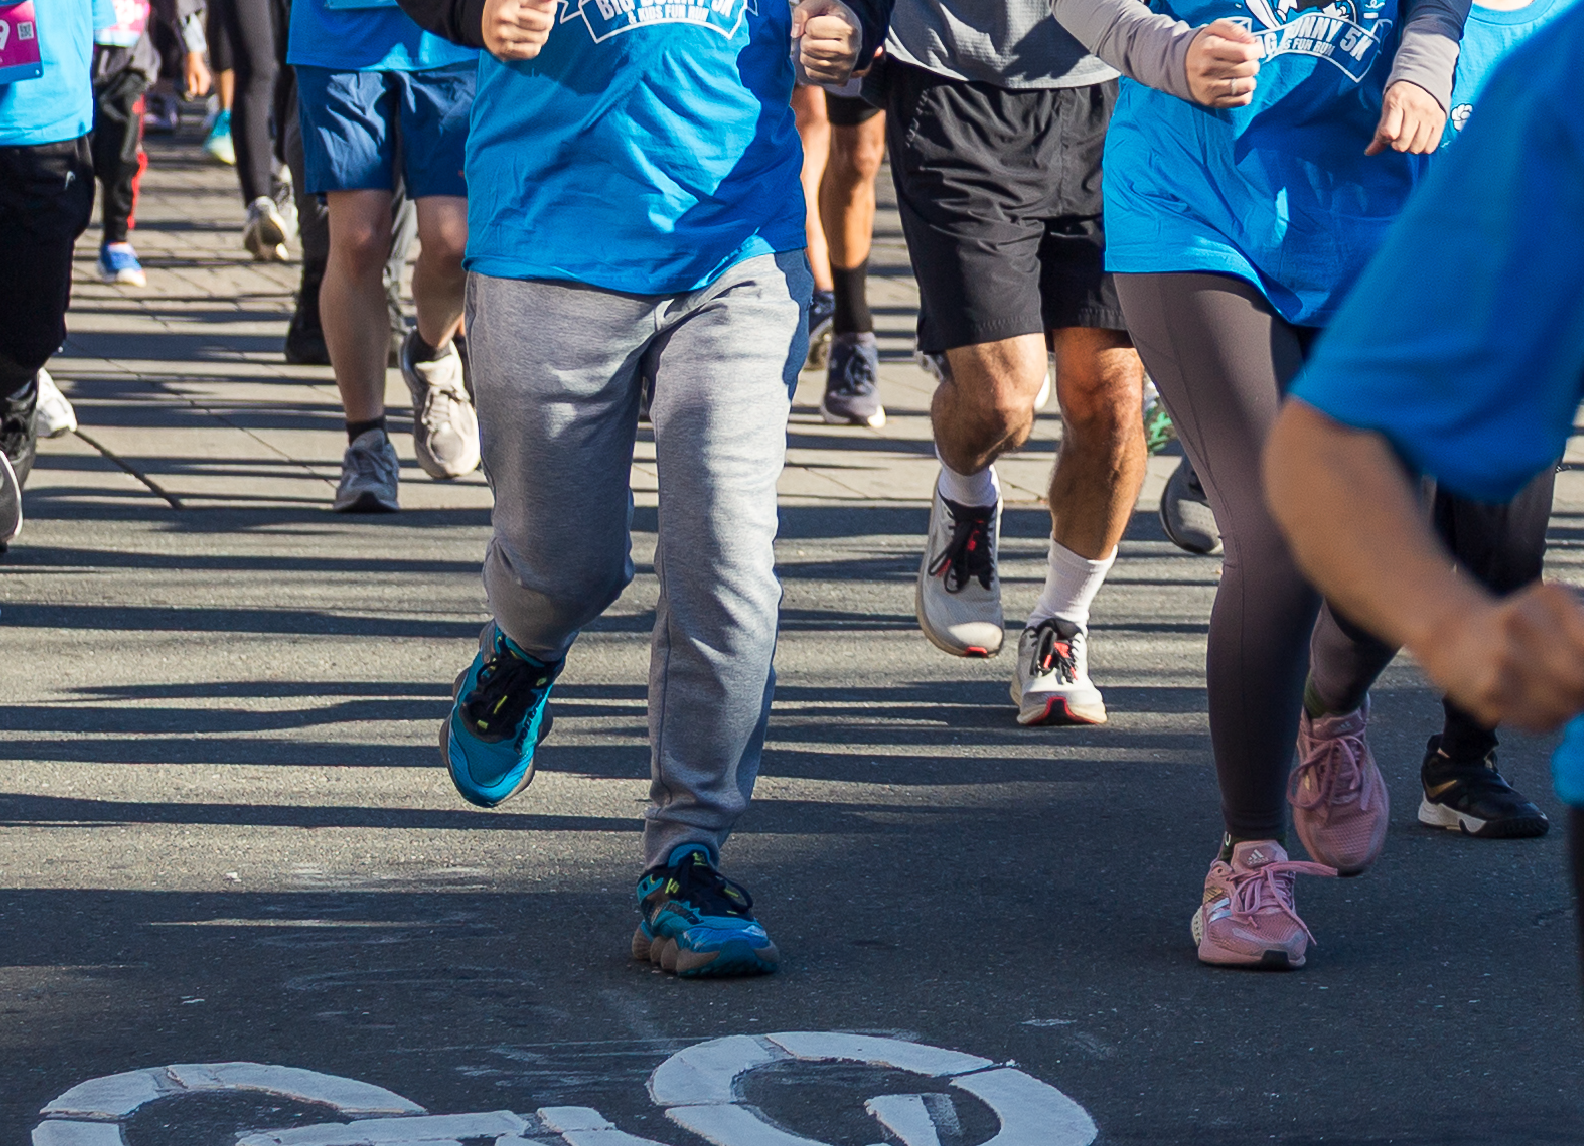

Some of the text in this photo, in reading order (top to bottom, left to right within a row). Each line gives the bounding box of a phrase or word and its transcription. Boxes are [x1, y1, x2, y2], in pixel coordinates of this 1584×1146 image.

[628, 5, 710, 25] & KIDS FUN RUN
[1292, 39, 1313, 51] FUN
[1340, 26, 1374, 62] 5K
